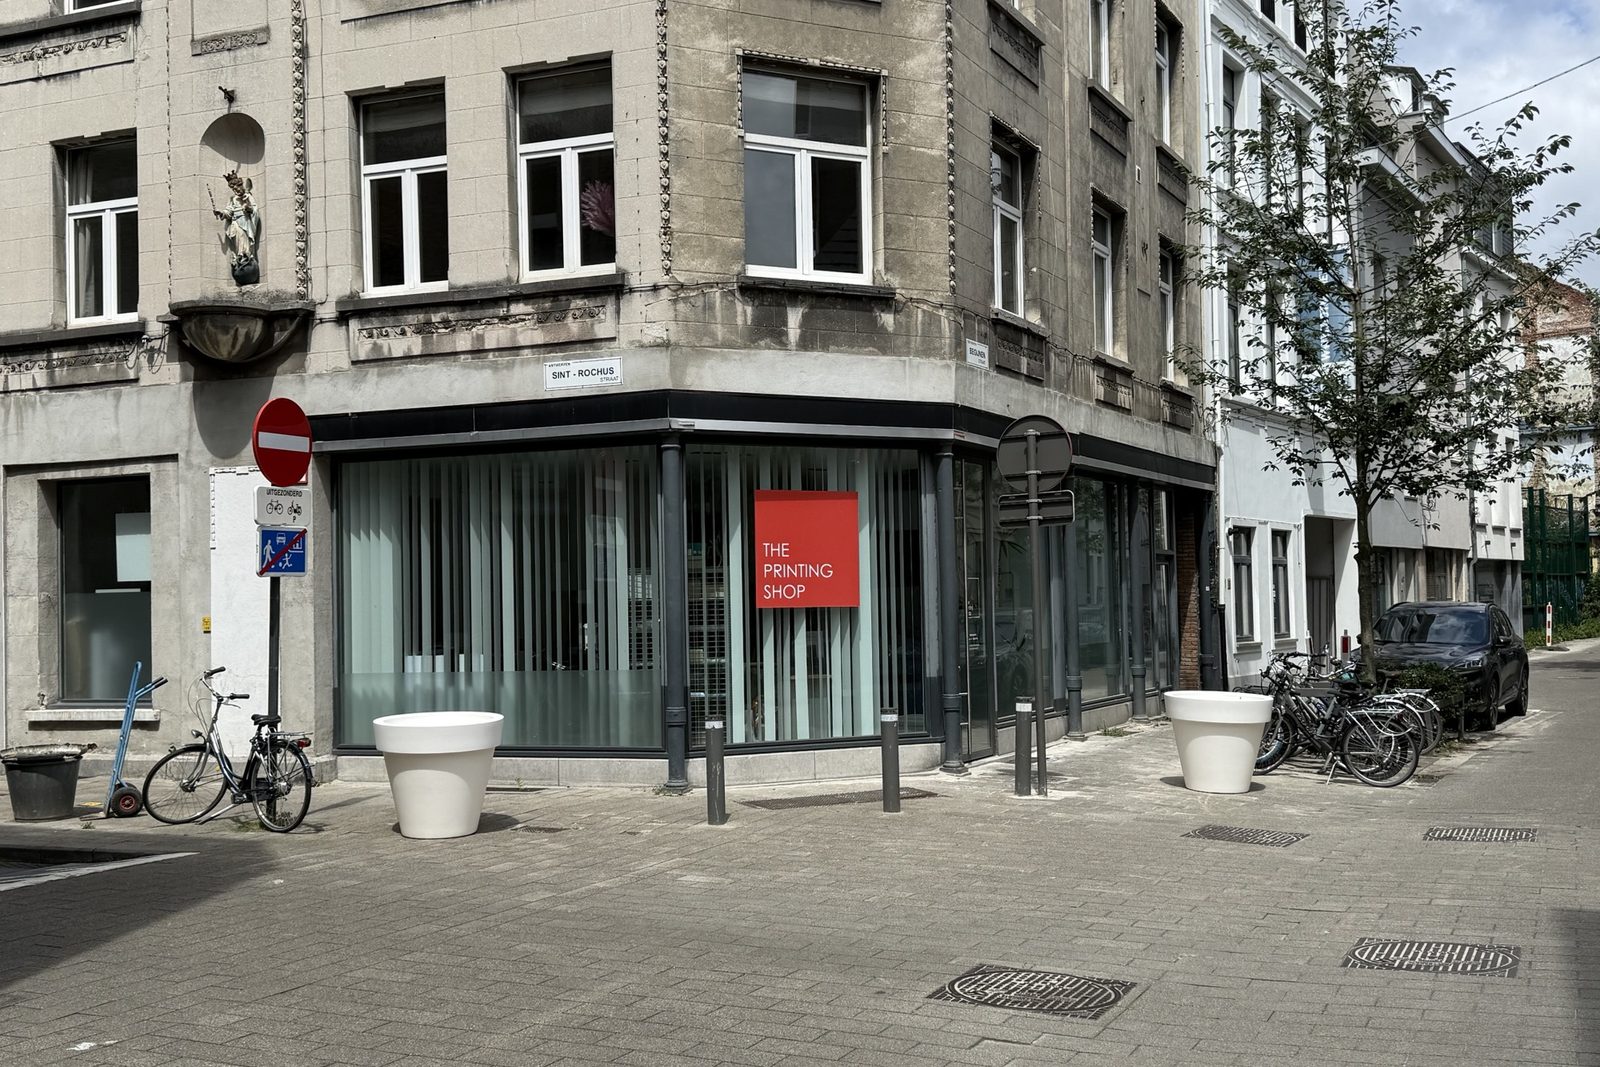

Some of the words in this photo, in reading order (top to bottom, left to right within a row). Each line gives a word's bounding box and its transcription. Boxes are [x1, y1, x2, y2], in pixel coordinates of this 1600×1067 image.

[552, 370, 571, 379] SINT
[578, 366, 615, 377] ROCHUS
[266, 489, 303, 497] UITGEZONDERD
[763, 542, 790, 557] THE
[763, 563, 833, 578] PRINTING
[763, 584, 806, 599] SHOP
